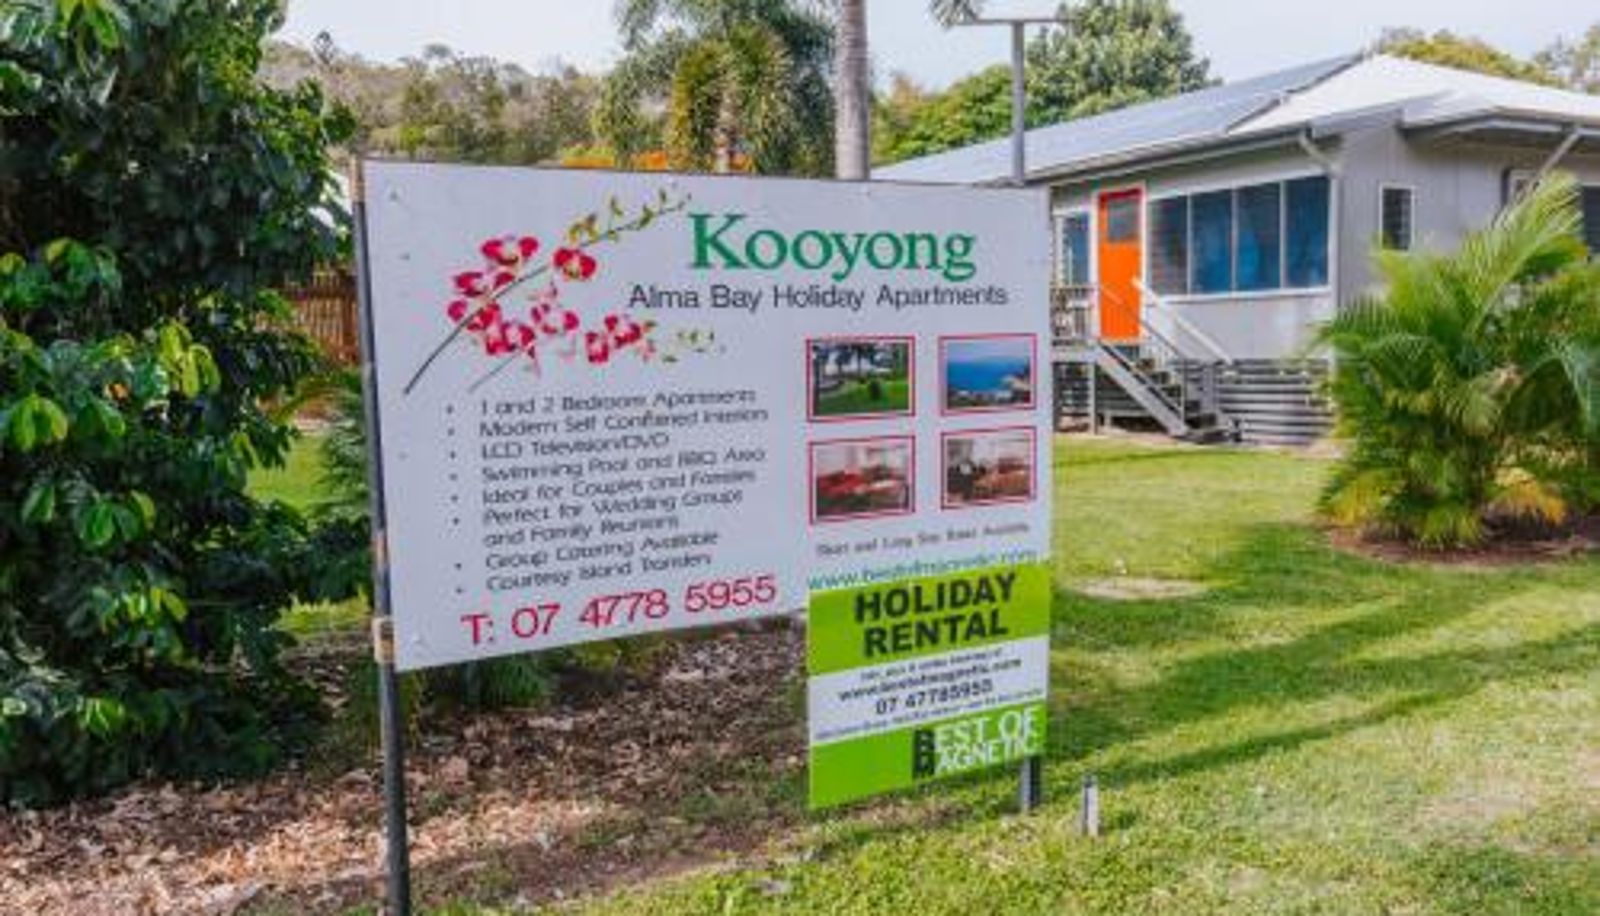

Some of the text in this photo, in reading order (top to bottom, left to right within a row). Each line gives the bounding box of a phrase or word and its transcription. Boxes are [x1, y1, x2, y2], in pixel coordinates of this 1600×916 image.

[689, 213, 977, 282] Kooyong
[628, 283, 1009, 313] Alma Bay Holiday Apartments
[495, 397, 535, 414] and
[479, 420, 558, 437] Modern
[564, 414, 597, 433] Self
[481, 441, 522, 460] LCD
[481, 463, 583, 480] Swimming
[588, 457, 629, 473] Pool
[636, 453, 672, 471] and
[482, 485, 529, 504] Ideal
[536, 482, 563, 499] for
[571, 479, 644, 498] Couples
[648, 471, 687, 490] and
[482, 505, 550, 526] Perfect
[558, 502, 583, 519] for
[592, 494, 677, 514] Wedding
[483, 528, 524, 548] and
[529, 522, 593, 542] Family
[485, 551, 549, 570] Group
[485, 570, 571, 590] Courtesy
[460, 574, 777, 646] T: 07 4778 5955
[854, 571, 1017, 624] HOLIDAY
[862, 608, 1009, 658] RENTAL
